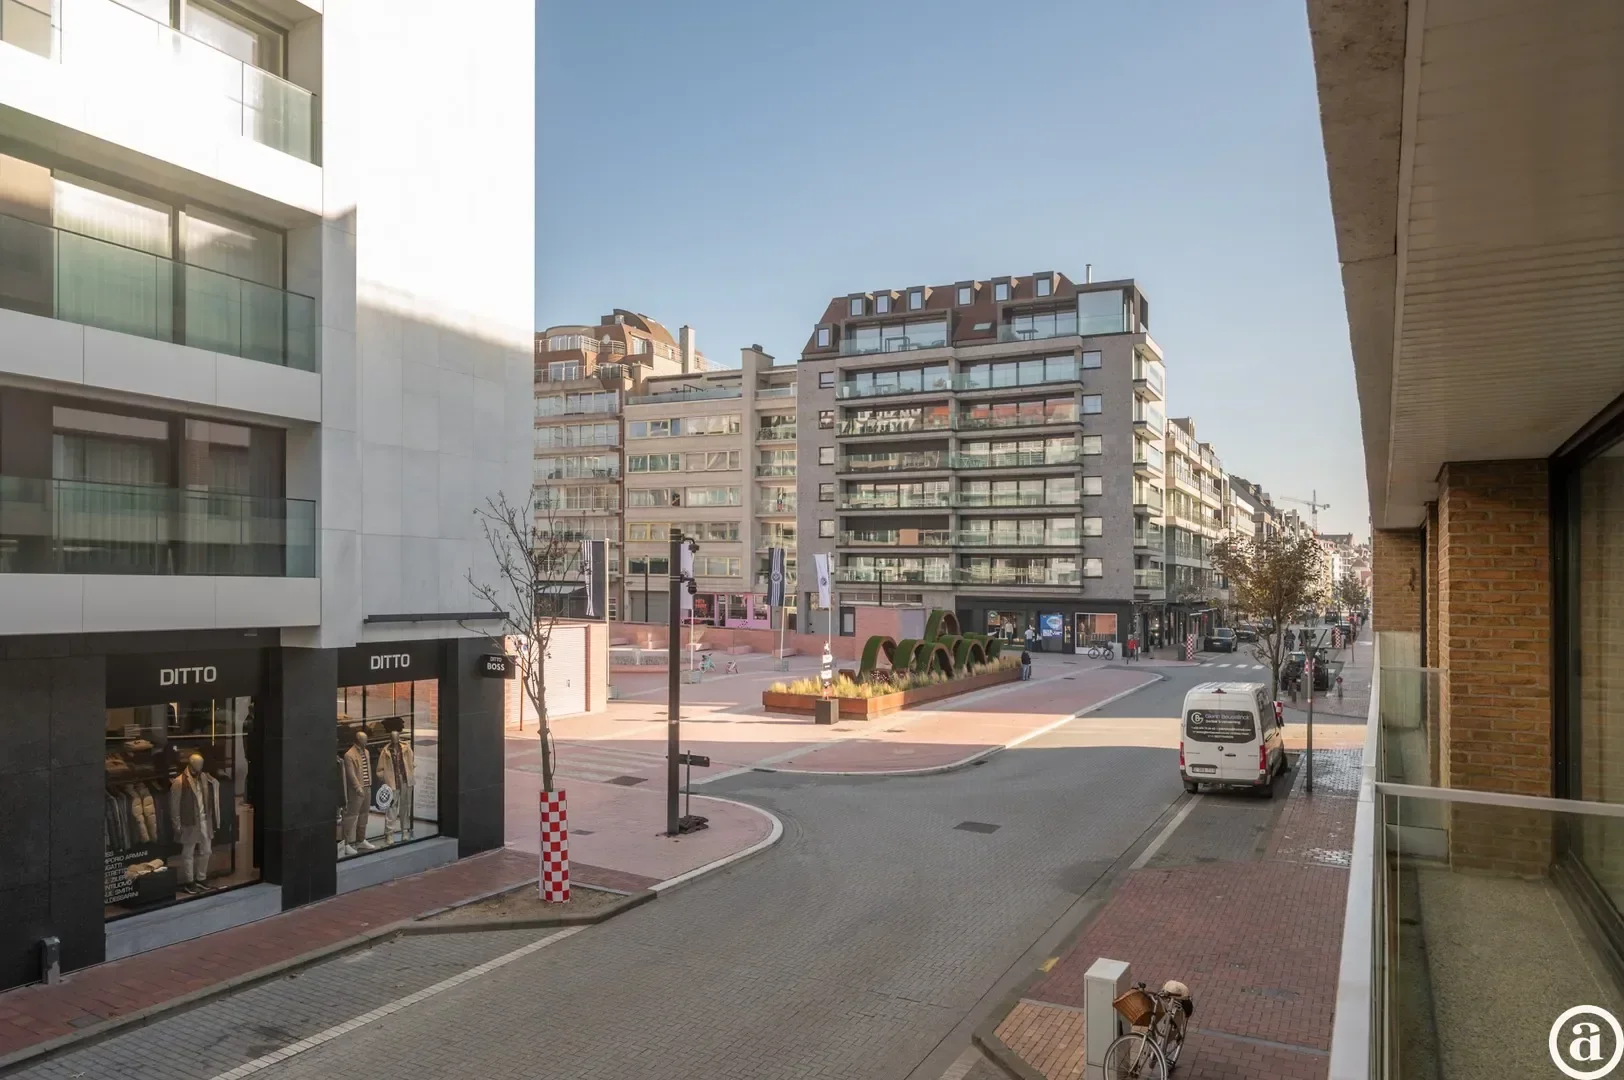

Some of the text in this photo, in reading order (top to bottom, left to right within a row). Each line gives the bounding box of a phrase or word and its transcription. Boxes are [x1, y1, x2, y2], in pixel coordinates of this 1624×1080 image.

[371, 653, 410, 670] DITTO
[487, 662, 505, 671] BOSS
[160, 666, 217, 686] DITTO
[125, 850, 148, 860] ARMANI
